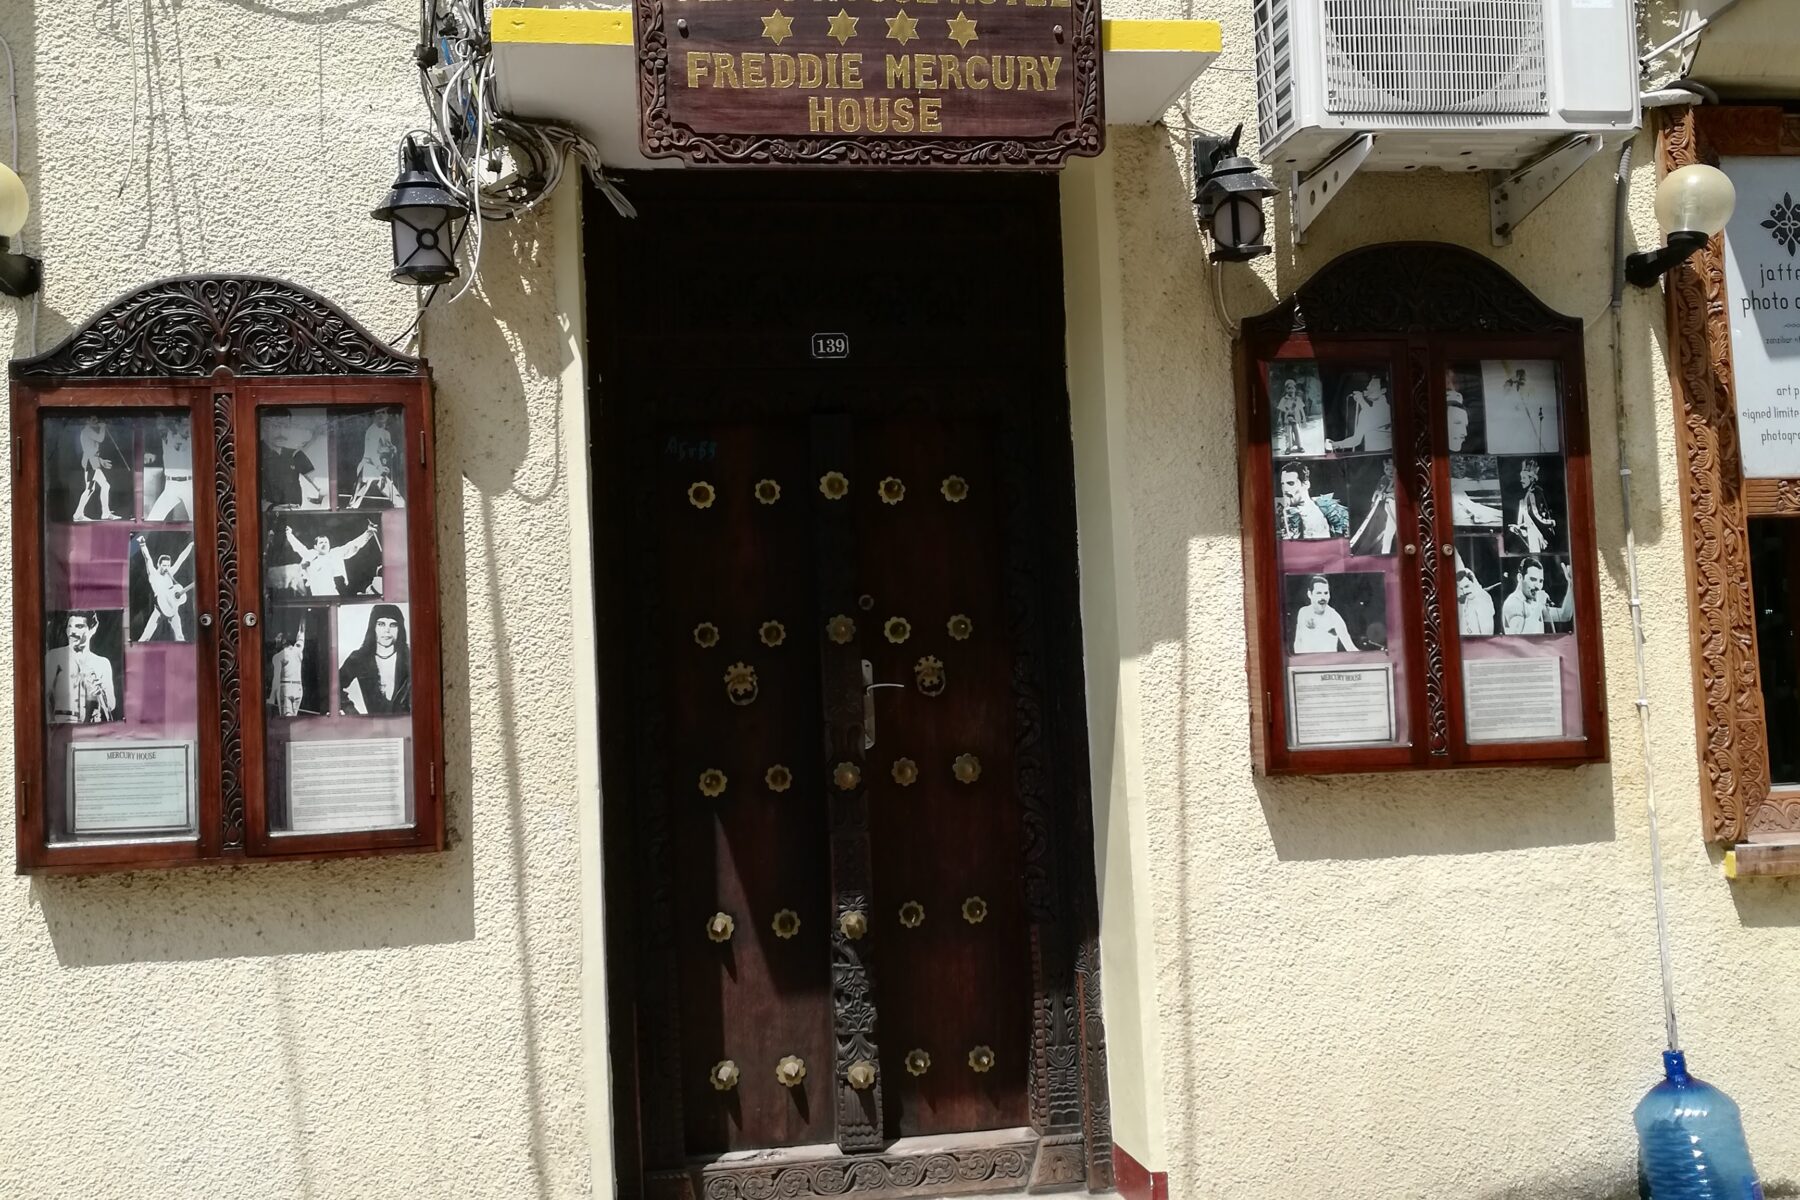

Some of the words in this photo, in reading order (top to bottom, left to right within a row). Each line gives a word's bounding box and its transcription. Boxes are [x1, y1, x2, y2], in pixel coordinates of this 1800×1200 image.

[687, 52, 864, 89] FREDDIE
[886, 54, 1063, 91] MERCURY
[808, 96, 943, 133] HOUSE
[1741, 289, 1789, 318] photo
[816, 338, 846, 353] 139
[1776, 384, 1791, 396] art
[106, 752, 136, 761] MERCURY
[136, 751, 157, 760] HOUSE
